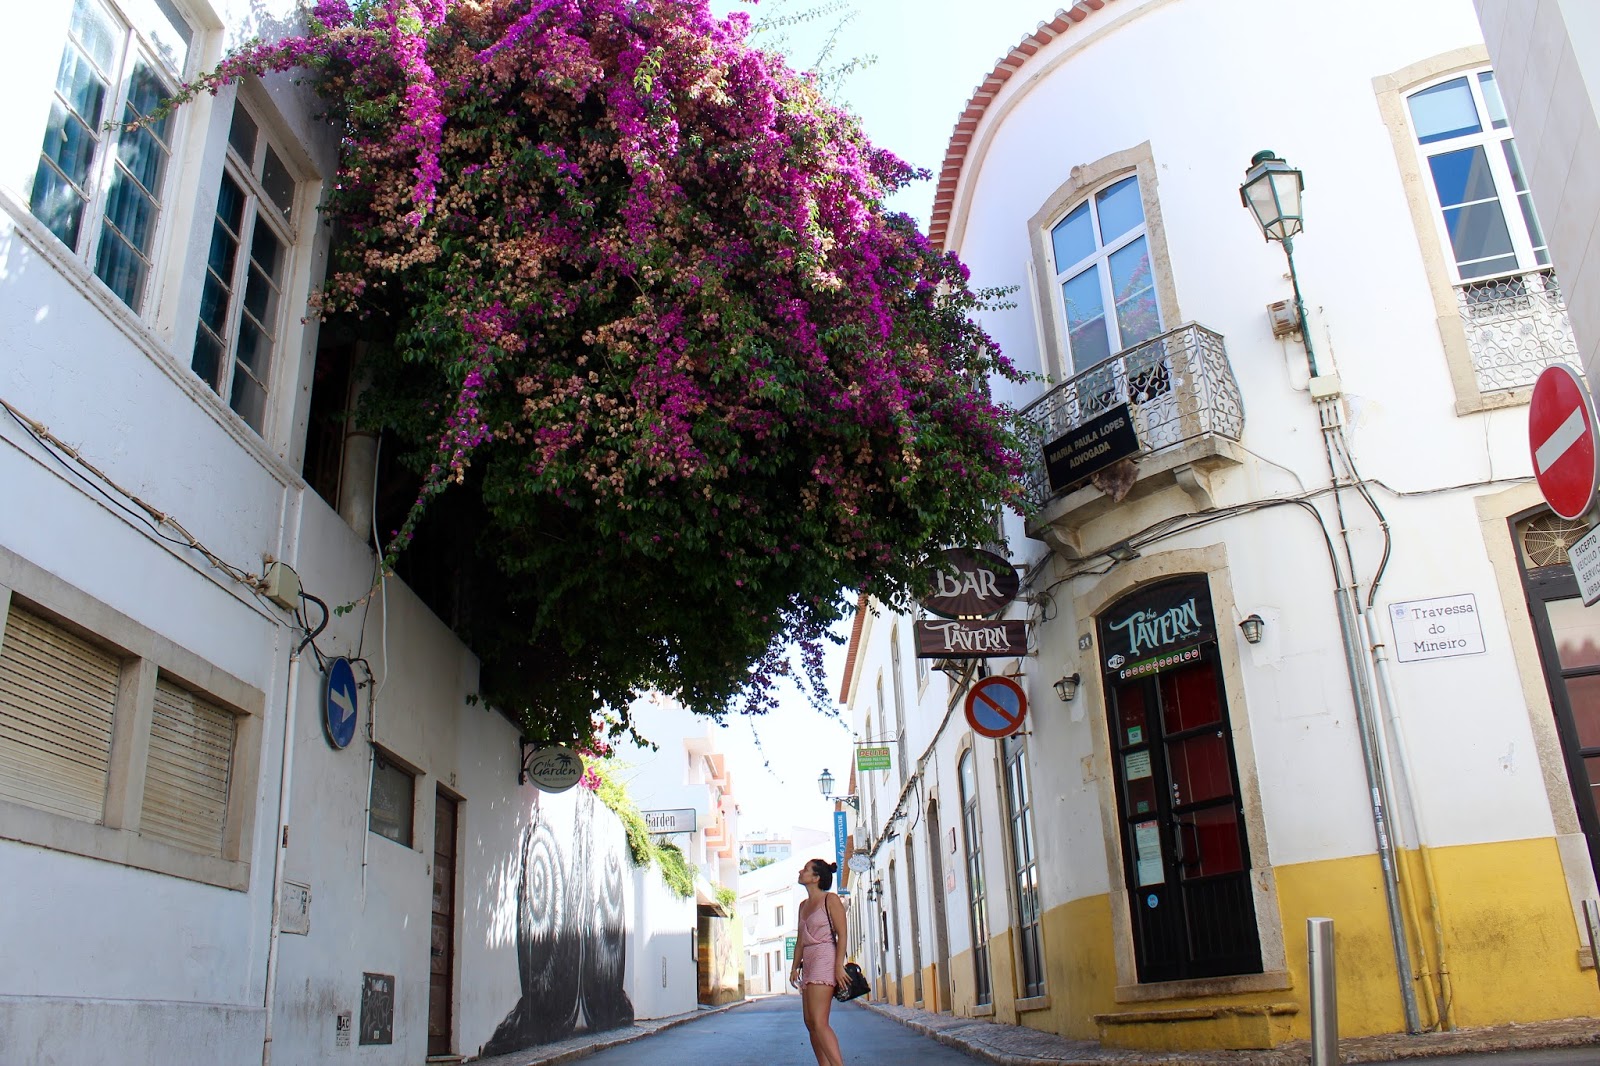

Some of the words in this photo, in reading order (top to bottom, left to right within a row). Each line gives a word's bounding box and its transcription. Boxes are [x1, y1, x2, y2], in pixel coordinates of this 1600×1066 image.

[1049, 445, 1073, 463] MARIA
[1074, 431, 1098, 450] PAULA
[1100, 417, 1125, 437] LOPES
[1069, 441, 1111, 469] ADVOGADA
[1575, 534, 1596, 557] EXCEPTO
[934, 563, 1004, 600] BAR
[1146, 608, 1157, 619] the
[1411, 604, 1475, 619] Travessa
[1109, 598, 1202, 656] TAVERN
[1428, 623, 1446, 634] do
[924, 622, 1012, 652] TAVERN
[1413, 639, 1467, 653] Mineiro
[533, 761, 576, 776] Garden
[544, 759, 555, 767] the
[646, 813, 675, 827] Garden
